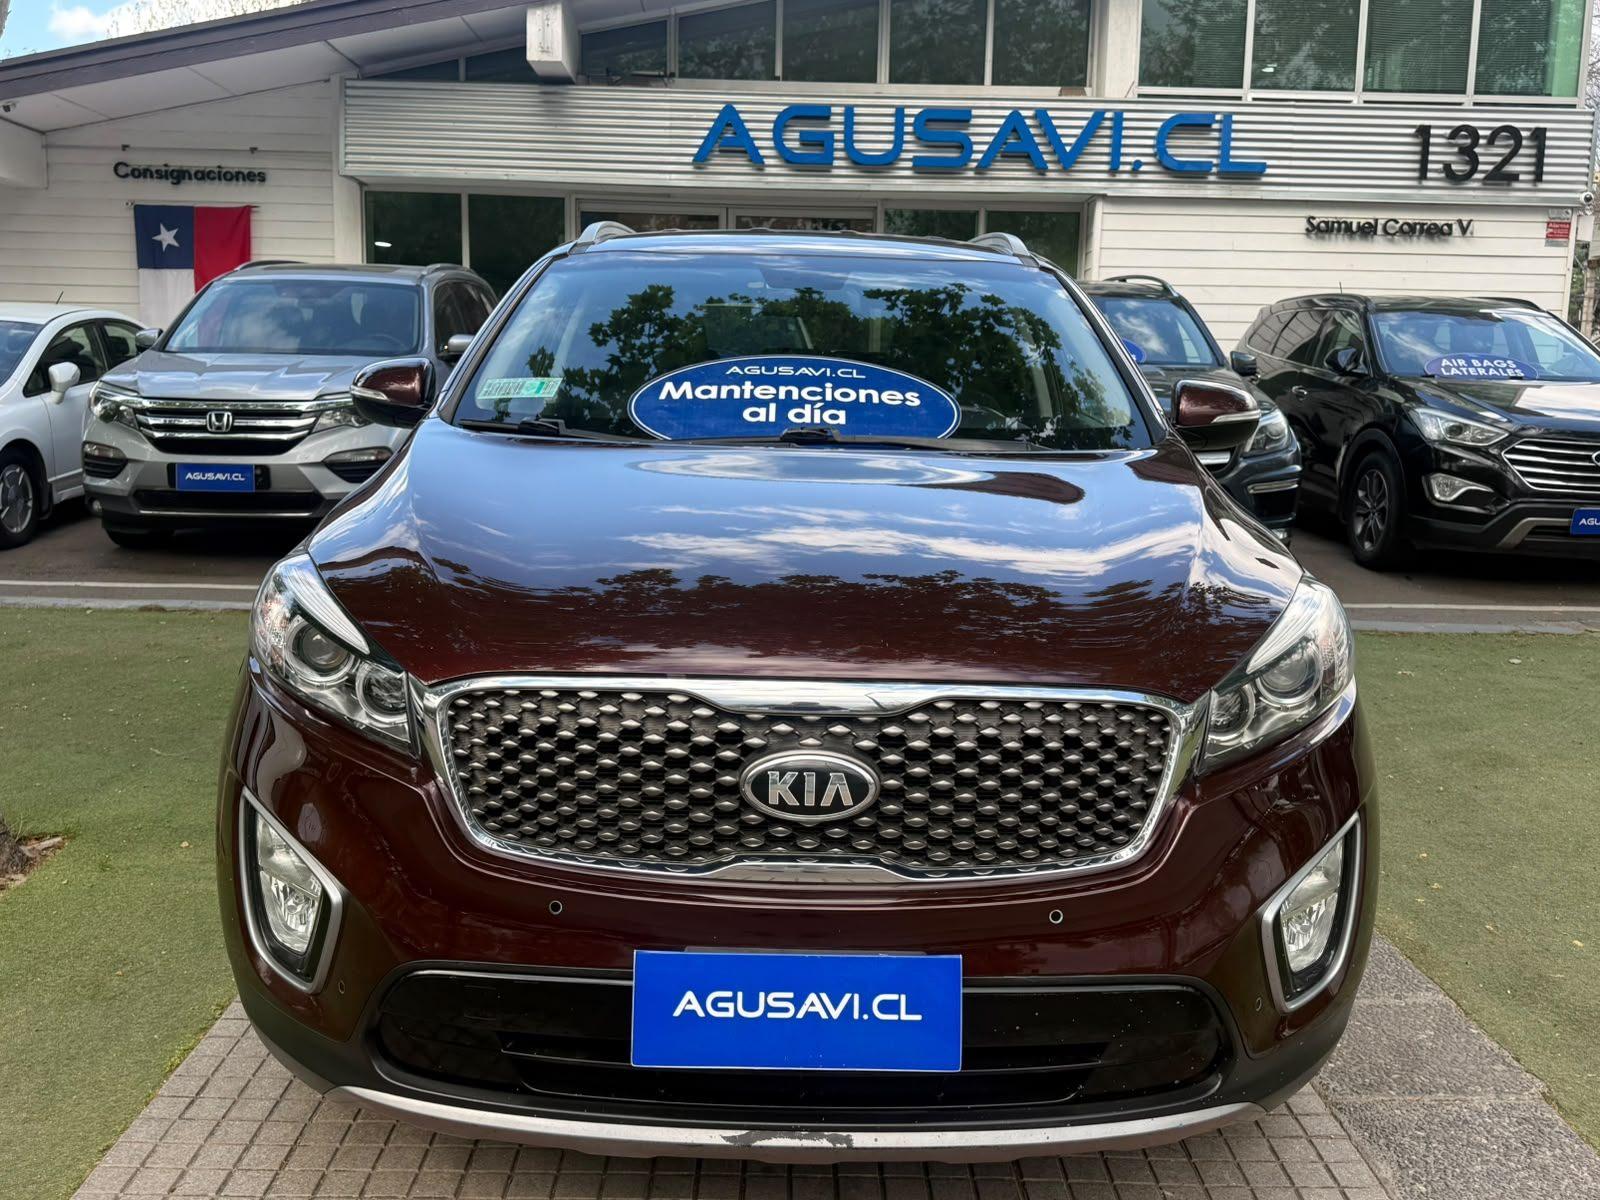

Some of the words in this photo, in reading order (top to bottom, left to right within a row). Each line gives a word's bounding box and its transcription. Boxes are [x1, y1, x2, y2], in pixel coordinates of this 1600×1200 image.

[692, 104, 1267, 174] AGUSAVI.CL
[1414, 124, 1547, 182] 1321
[113, 161, 266, 185] Consignaciones
[1305, 215, 1378, 236] Samuel
[1382, 218, 1453, 237] Correa
[725, 366, 866, 379] AGUSAVI.CL
[1440, 358, 1468, 367] AIR
[1471, 359, 1517, 368] BAGS
[1440, 367, 1525, 377] LATERALES
[658, 380, 921, 407] Mantenciones
[742, 403, 776, 423] al
[788, 402, 846, 425] día
[185, 472, 246, 482] AGUSAVI.CL
[768, 771, 854, 806] KIA
[673, 990, 922, 1021] AGUSAVI.CL
